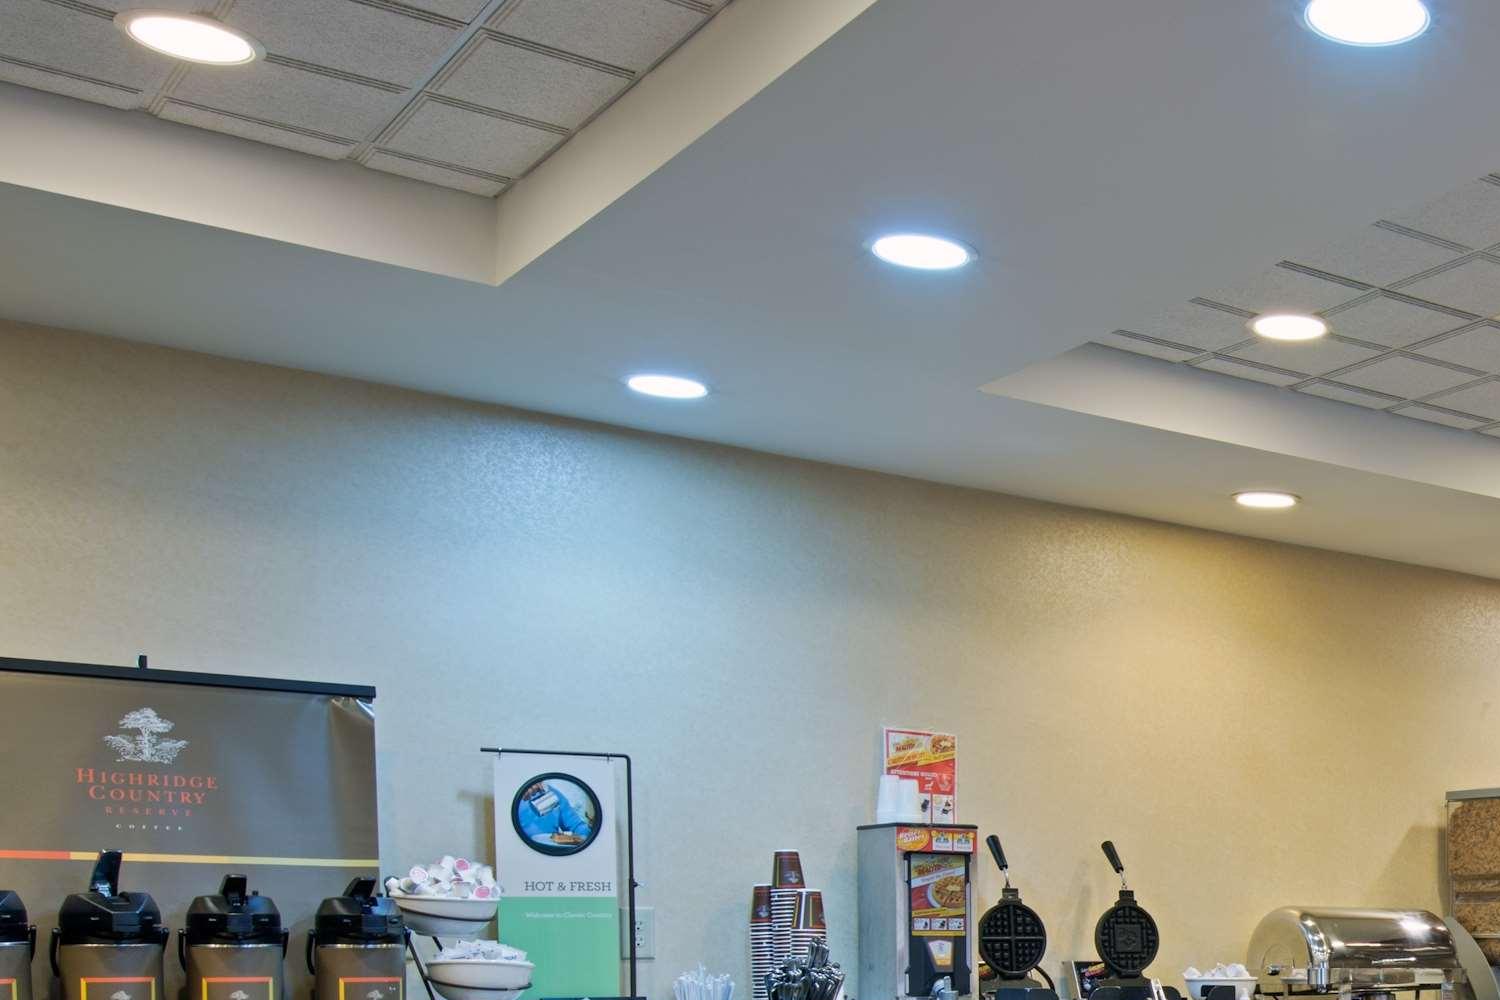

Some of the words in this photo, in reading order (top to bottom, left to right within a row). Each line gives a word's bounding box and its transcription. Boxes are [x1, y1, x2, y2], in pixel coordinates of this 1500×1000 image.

[75, 767, 218, 790] HIGHRIDGE
[88, 785, 208, 805] COUNTRY
[104, 805, 193, 817] RESERVE
[524, 880, 554, 892] HOT
[557, 880, 567, 892] &
[569, 880, 612, 892] FRESH
